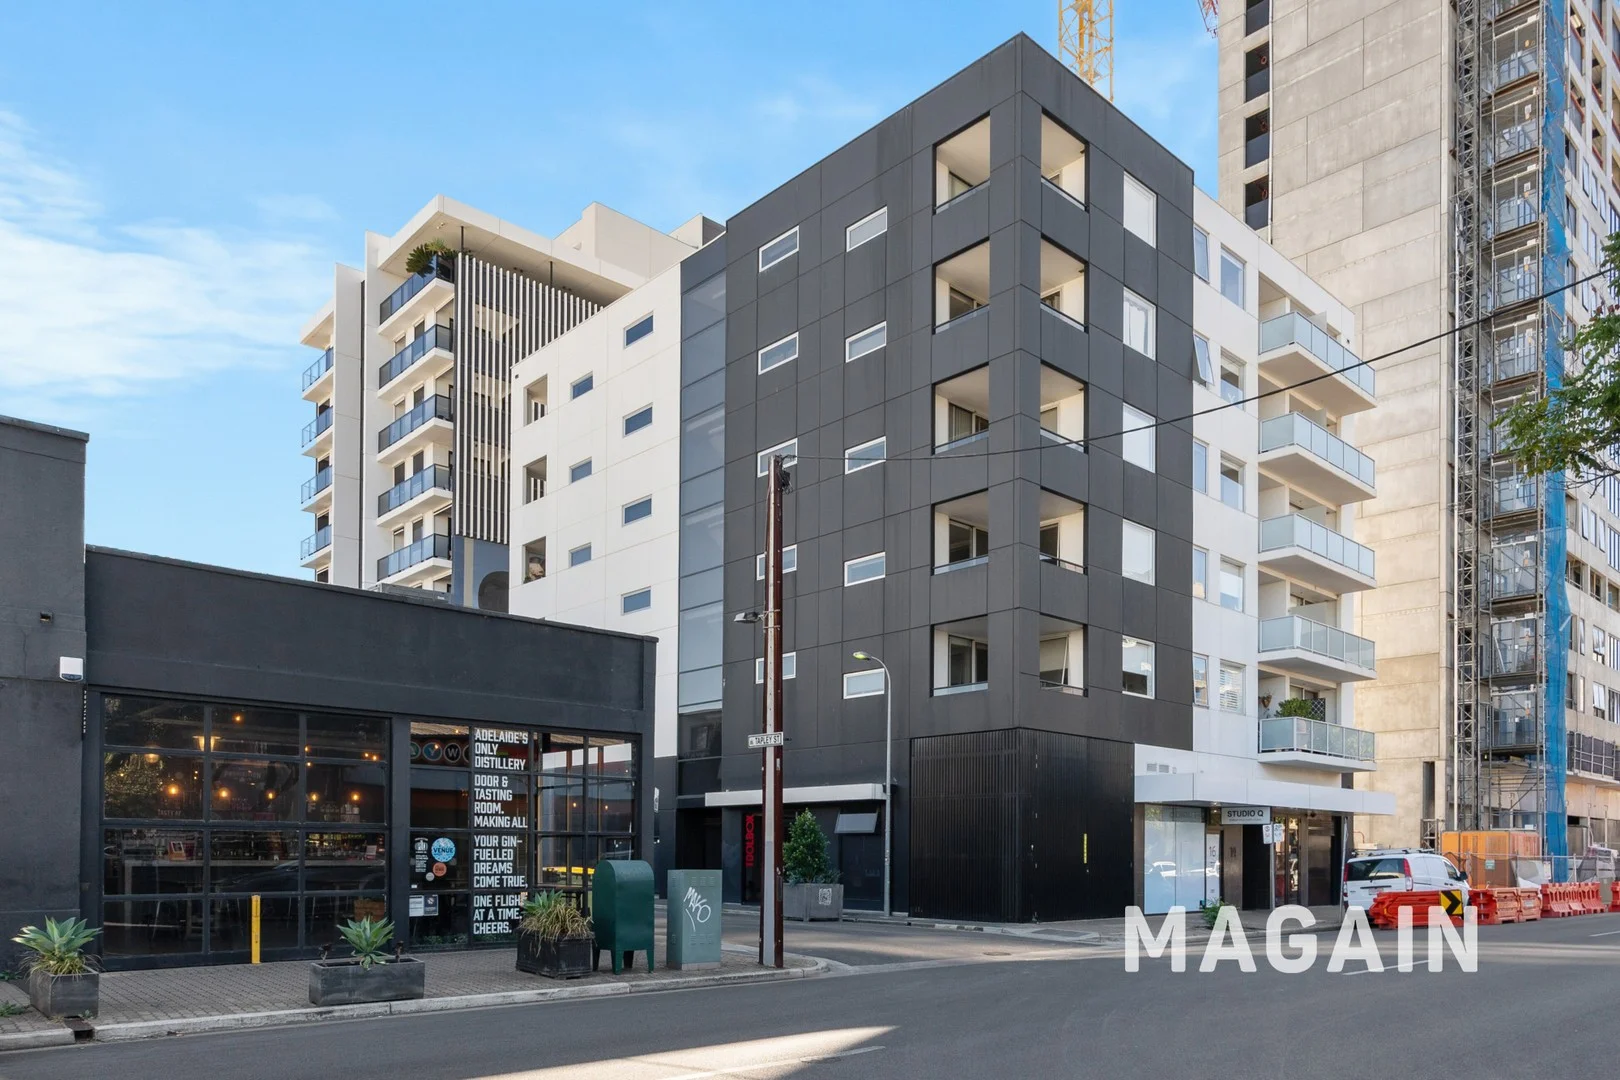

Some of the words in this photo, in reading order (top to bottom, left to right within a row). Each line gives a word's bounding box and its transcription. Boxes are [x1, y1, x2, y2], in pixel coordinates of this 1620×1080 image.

[474, 728, 528, 744] ADELAIDE'S
[755, 735, 772, 745] TAPLEY
[773, 734, 780, 743] ST
[474, 742, 498, 756] ONLY
[474, 756, 526, 770] DISTILLERY
[474, 774, 499, 787] DOOR
[501, 776, 509, 788] &
[474, 788, 513, 801] TASTING
[474, 801, 504, 815] ROOM.
[1227, 810, 1256, 818] STUDIO
[1257, 809, 1264, 817] Q
[474, 815, 511, 828] MAKING
[511, 816, 528, 829] ALL
[474, 835, 499, 847] YOUR
[501, 835, 523, 847] GIN-
[474, 848, 514, 861] FUELLED
[474, 862, 513, 875] DREAMS
[474, 876, 501, 888] COME
[501, 875, 528, 889] TRUE,
[474, 895, 493, 907] ONE
[474, 908, 486, 921] AT
[487, 908, 495, 920] A
[496, 907, 523, 920] TIME.
[473, 921, 512, 935] CHEERS.
